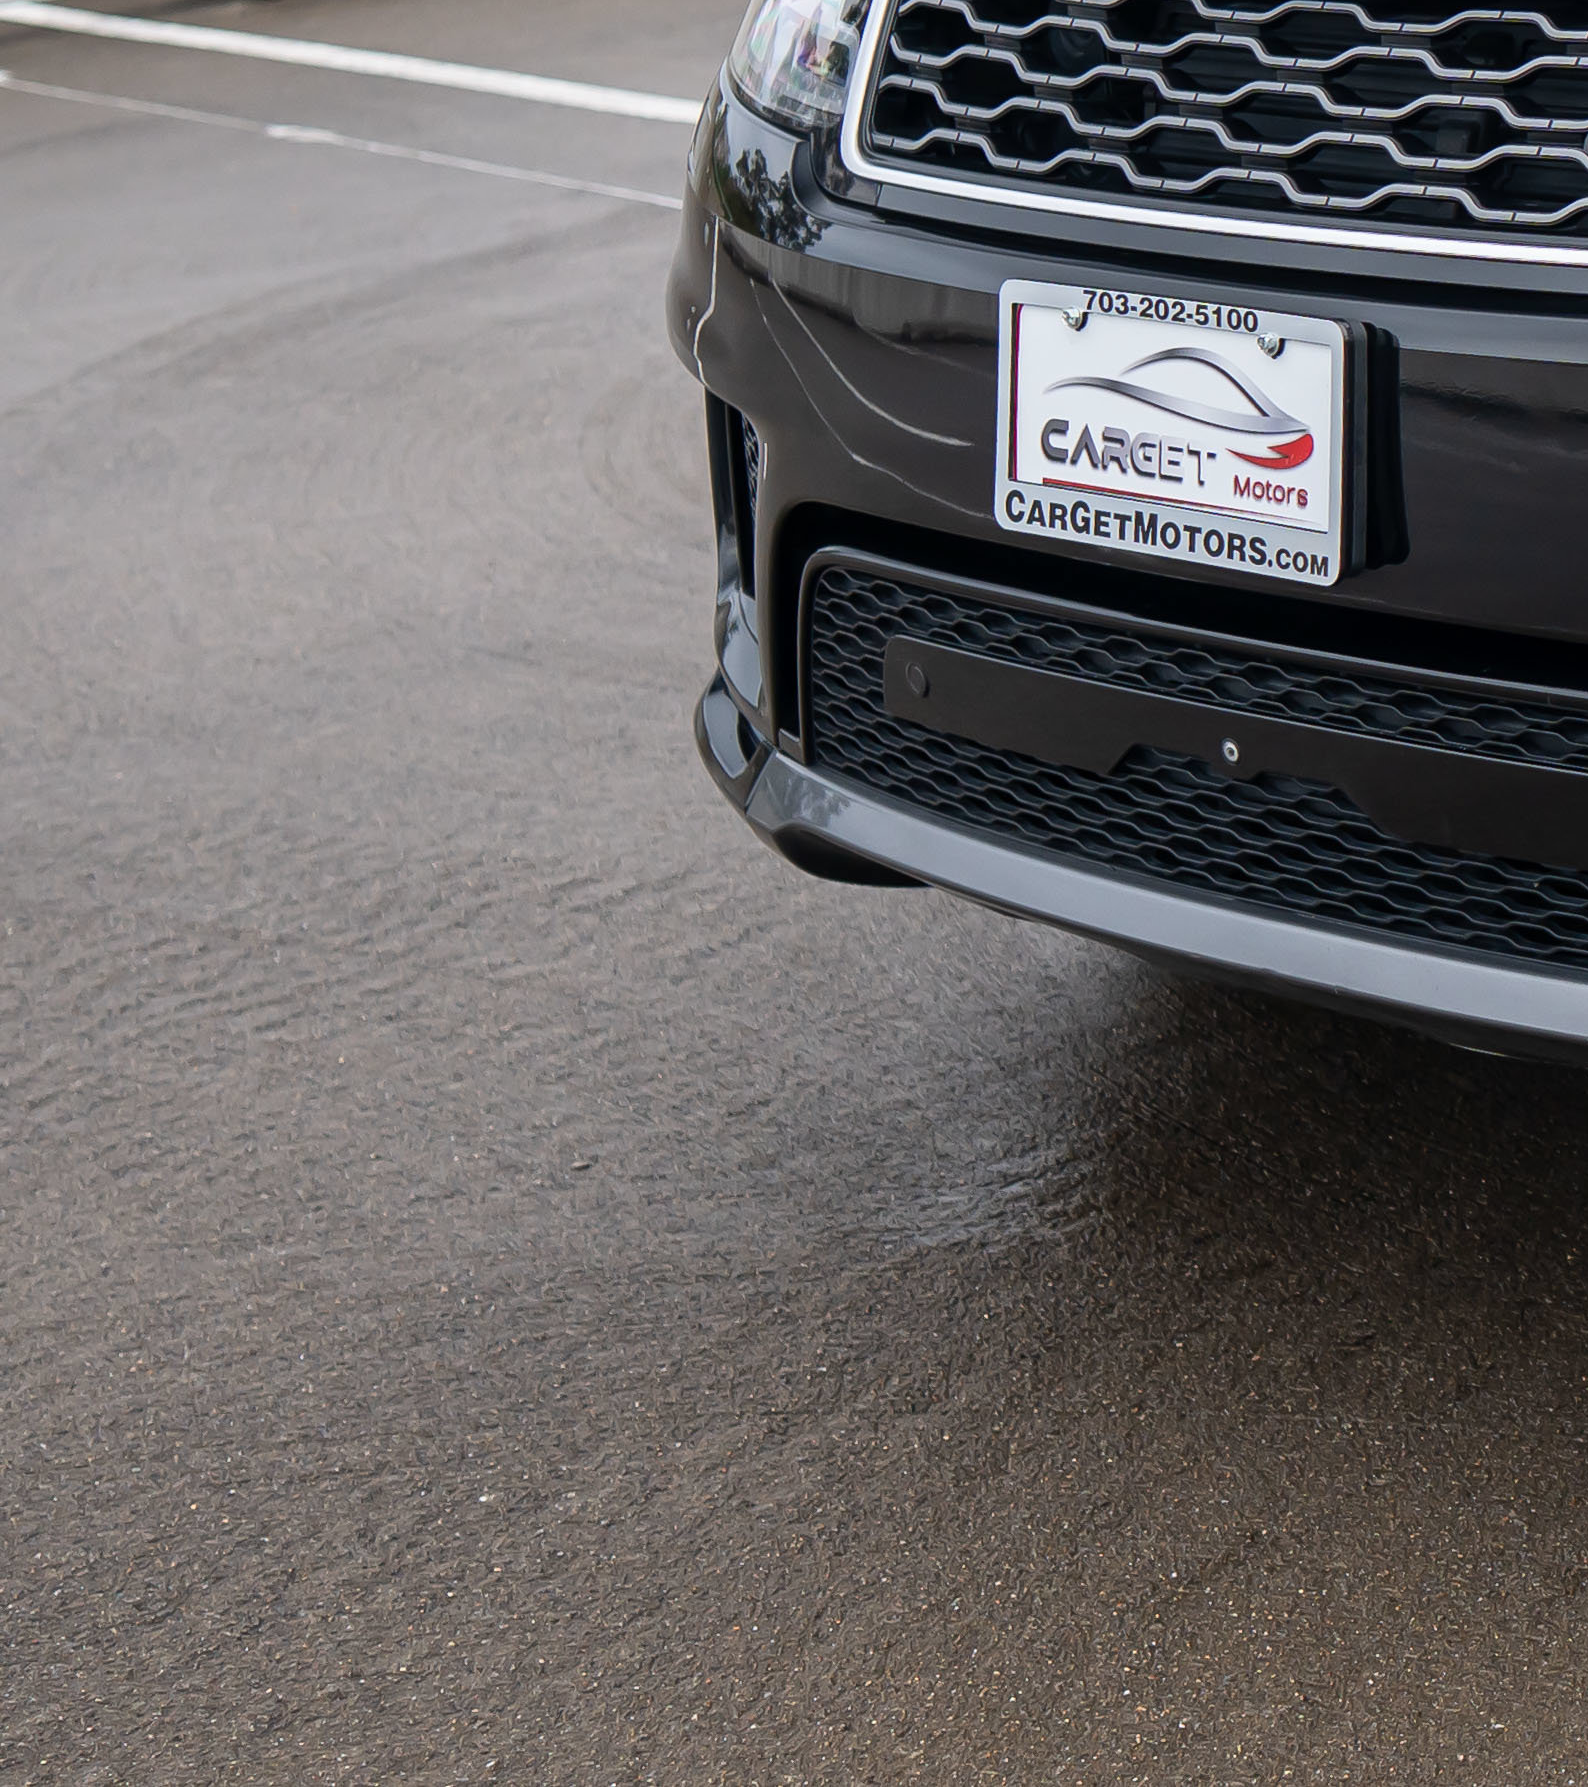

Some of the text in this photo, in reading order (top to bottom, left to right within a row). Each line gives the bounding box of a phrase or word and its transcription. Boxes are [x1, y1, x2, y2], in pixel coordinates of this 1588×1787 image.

[1082, 289, 1259, 333] 703-202-5100
[1040, 418, 1217, 486] CARGET
[1233, 475, 1309, 508] Motors
